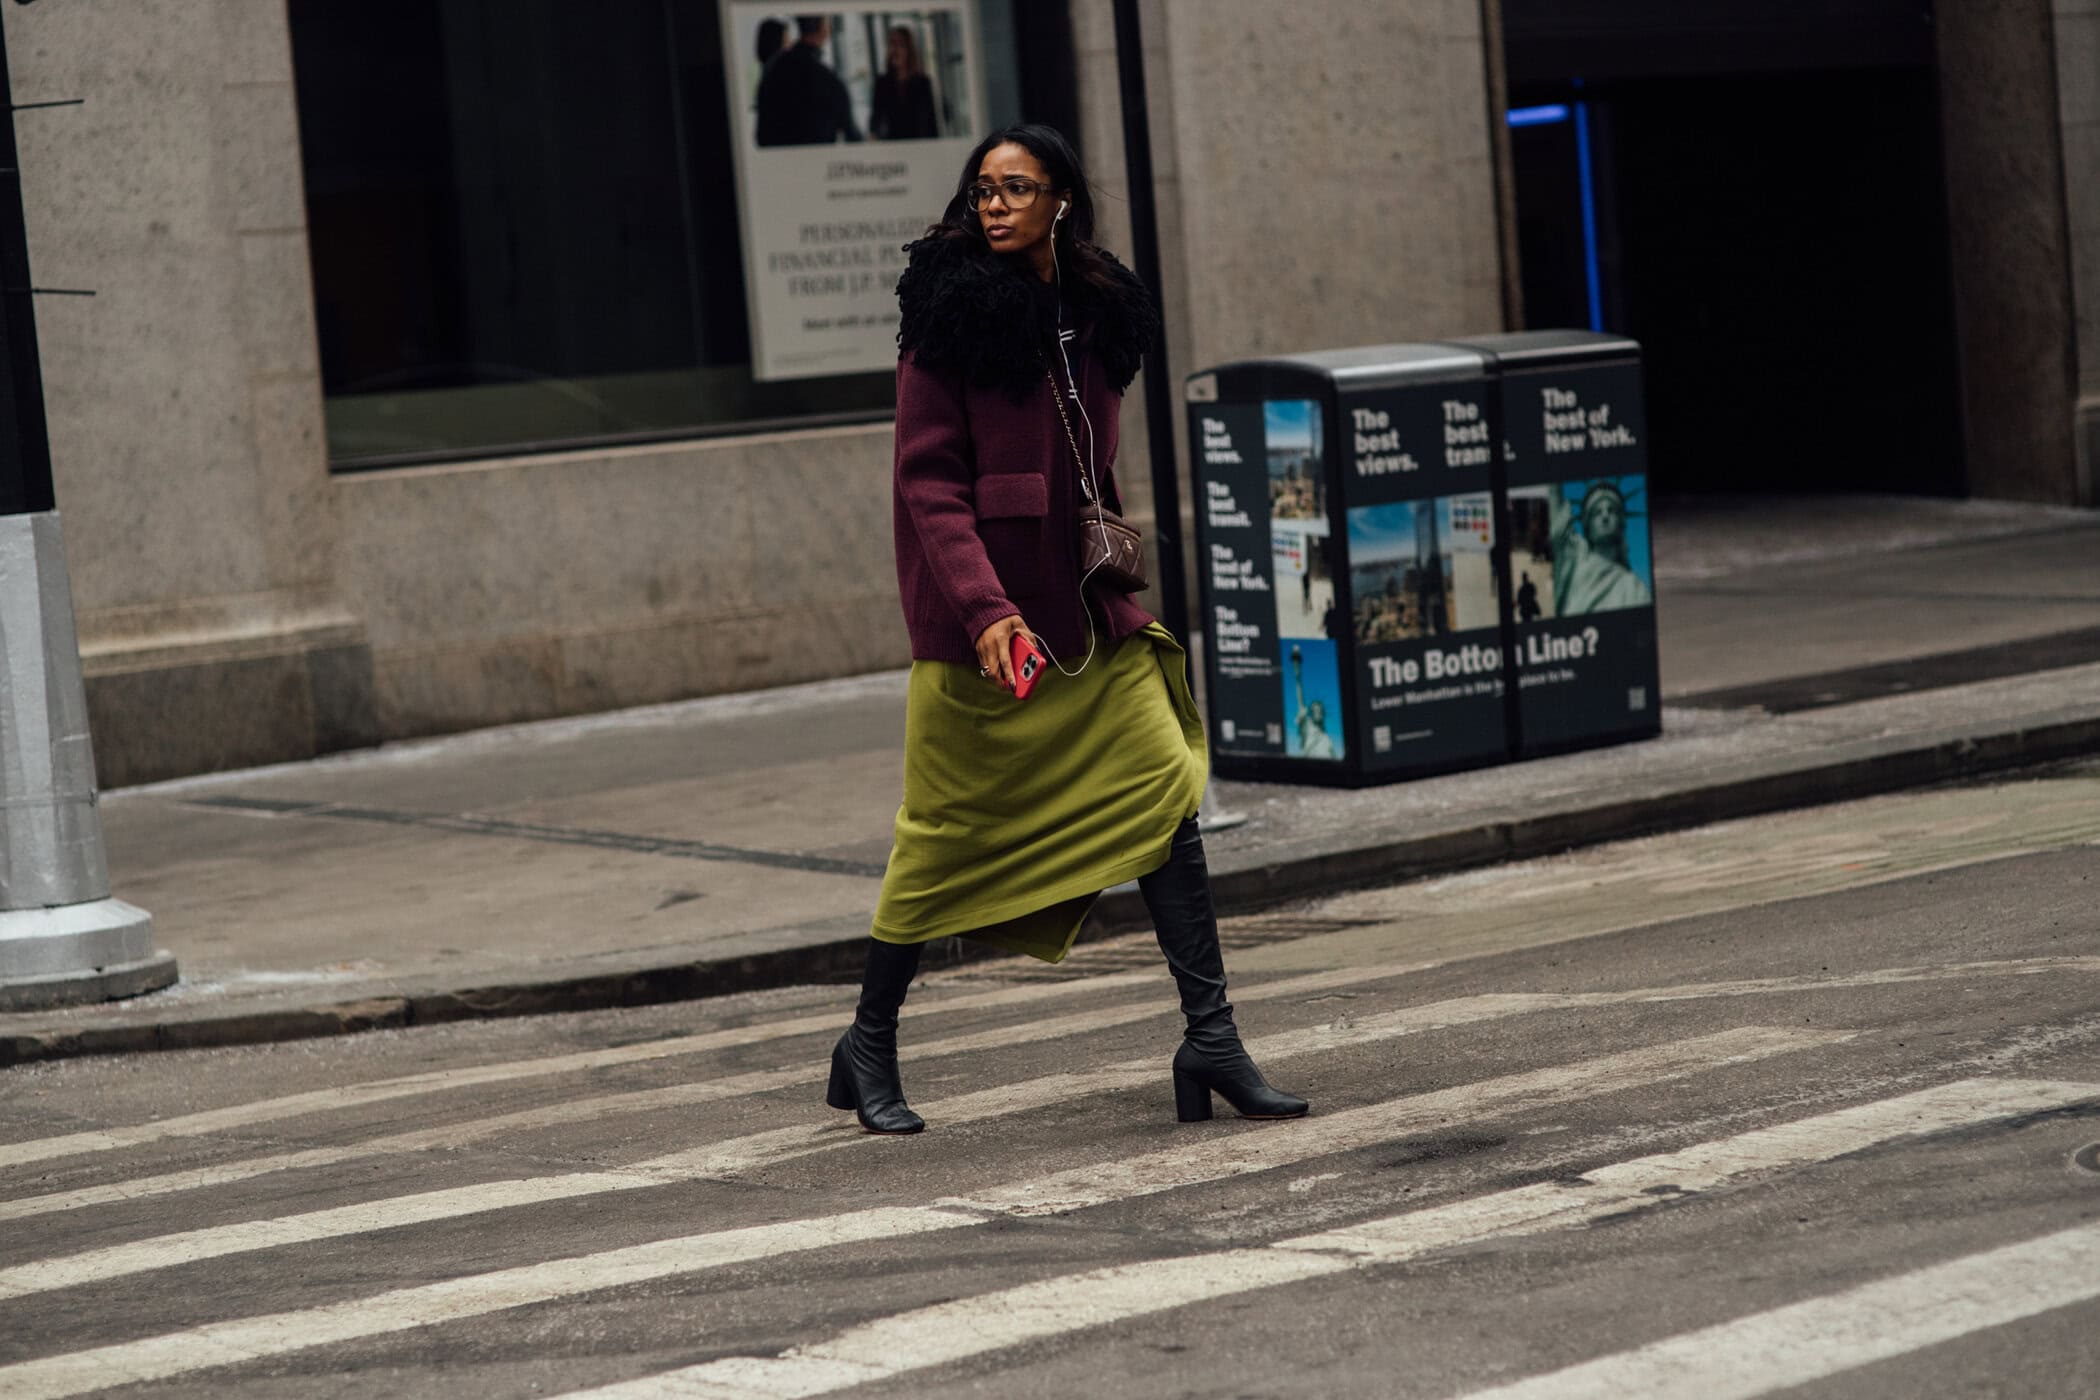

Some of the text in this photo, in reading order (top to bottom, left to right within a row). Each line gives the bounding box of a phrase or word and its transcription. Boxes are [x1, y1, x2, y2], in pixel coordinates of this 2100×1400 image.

[1543, 388, 1576, 408] The
[1353, 409, 1389, 429] The
[1443, 401, 1478, 420] The
[1545, 404, 1608, 430] best of
[1203, 418, 1225, 433] The
[1446, 420, 1487, 444] best
[1355, 429, 1399, 452] best
[1546, 425, 1636, 452] New York.
[1357, 454, 1418, 475] views.
[1369, 656, 1419, 687] The
[1528, 627, 1598, 663] Line?
